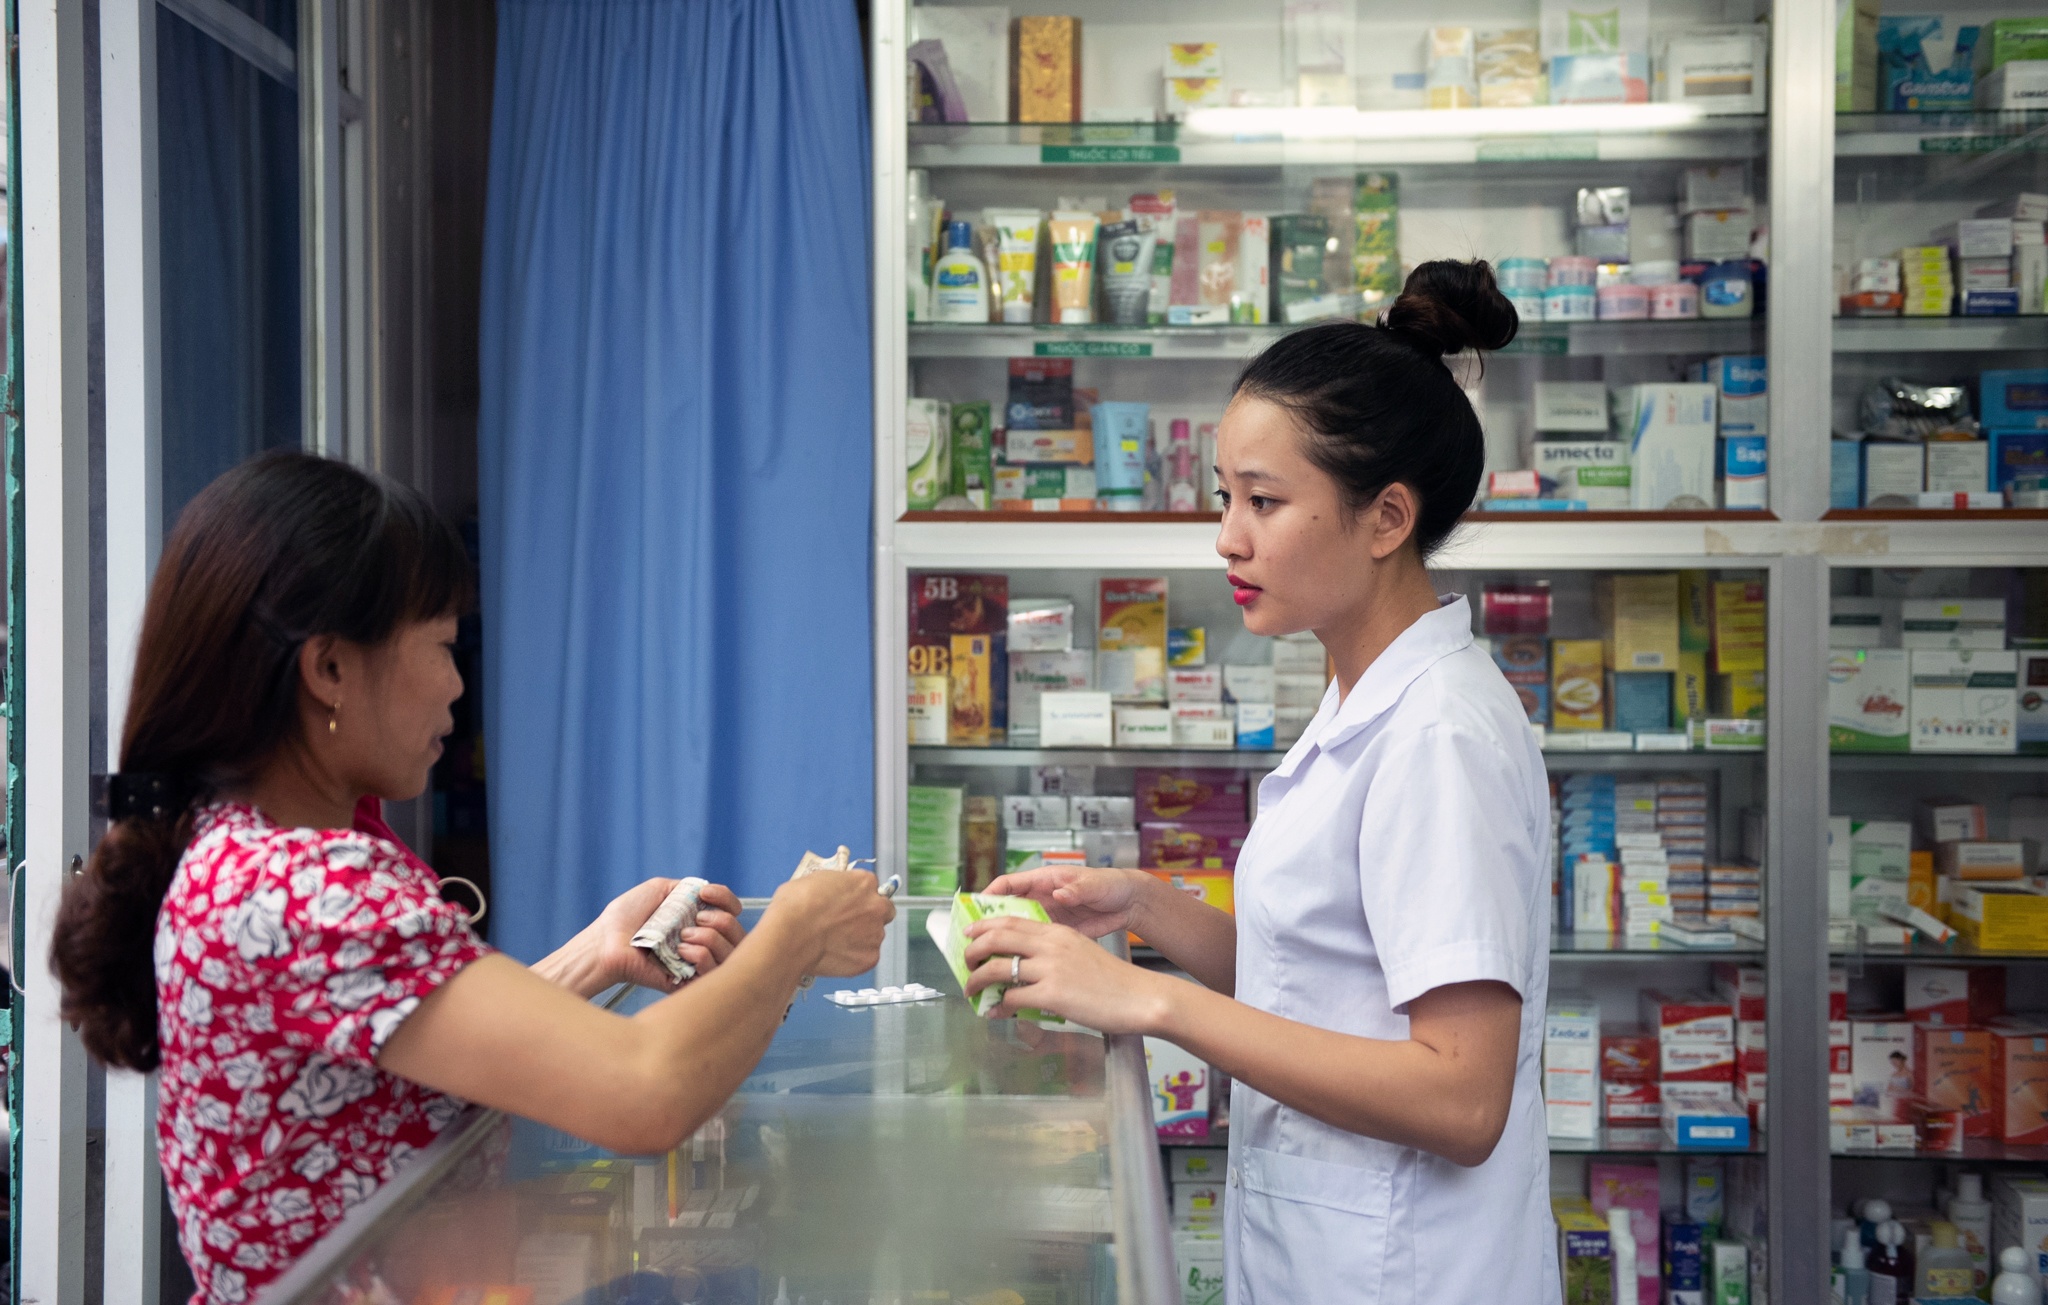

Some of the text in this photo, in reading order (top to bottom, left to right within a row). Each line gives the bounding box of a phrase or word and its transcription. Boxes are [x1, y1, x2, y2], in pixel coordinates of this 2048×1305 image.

[1544, 446, 1614, 460] smecta
[924, 576, 958, 600] 5B
[908, 644, 950, 675] 9B
